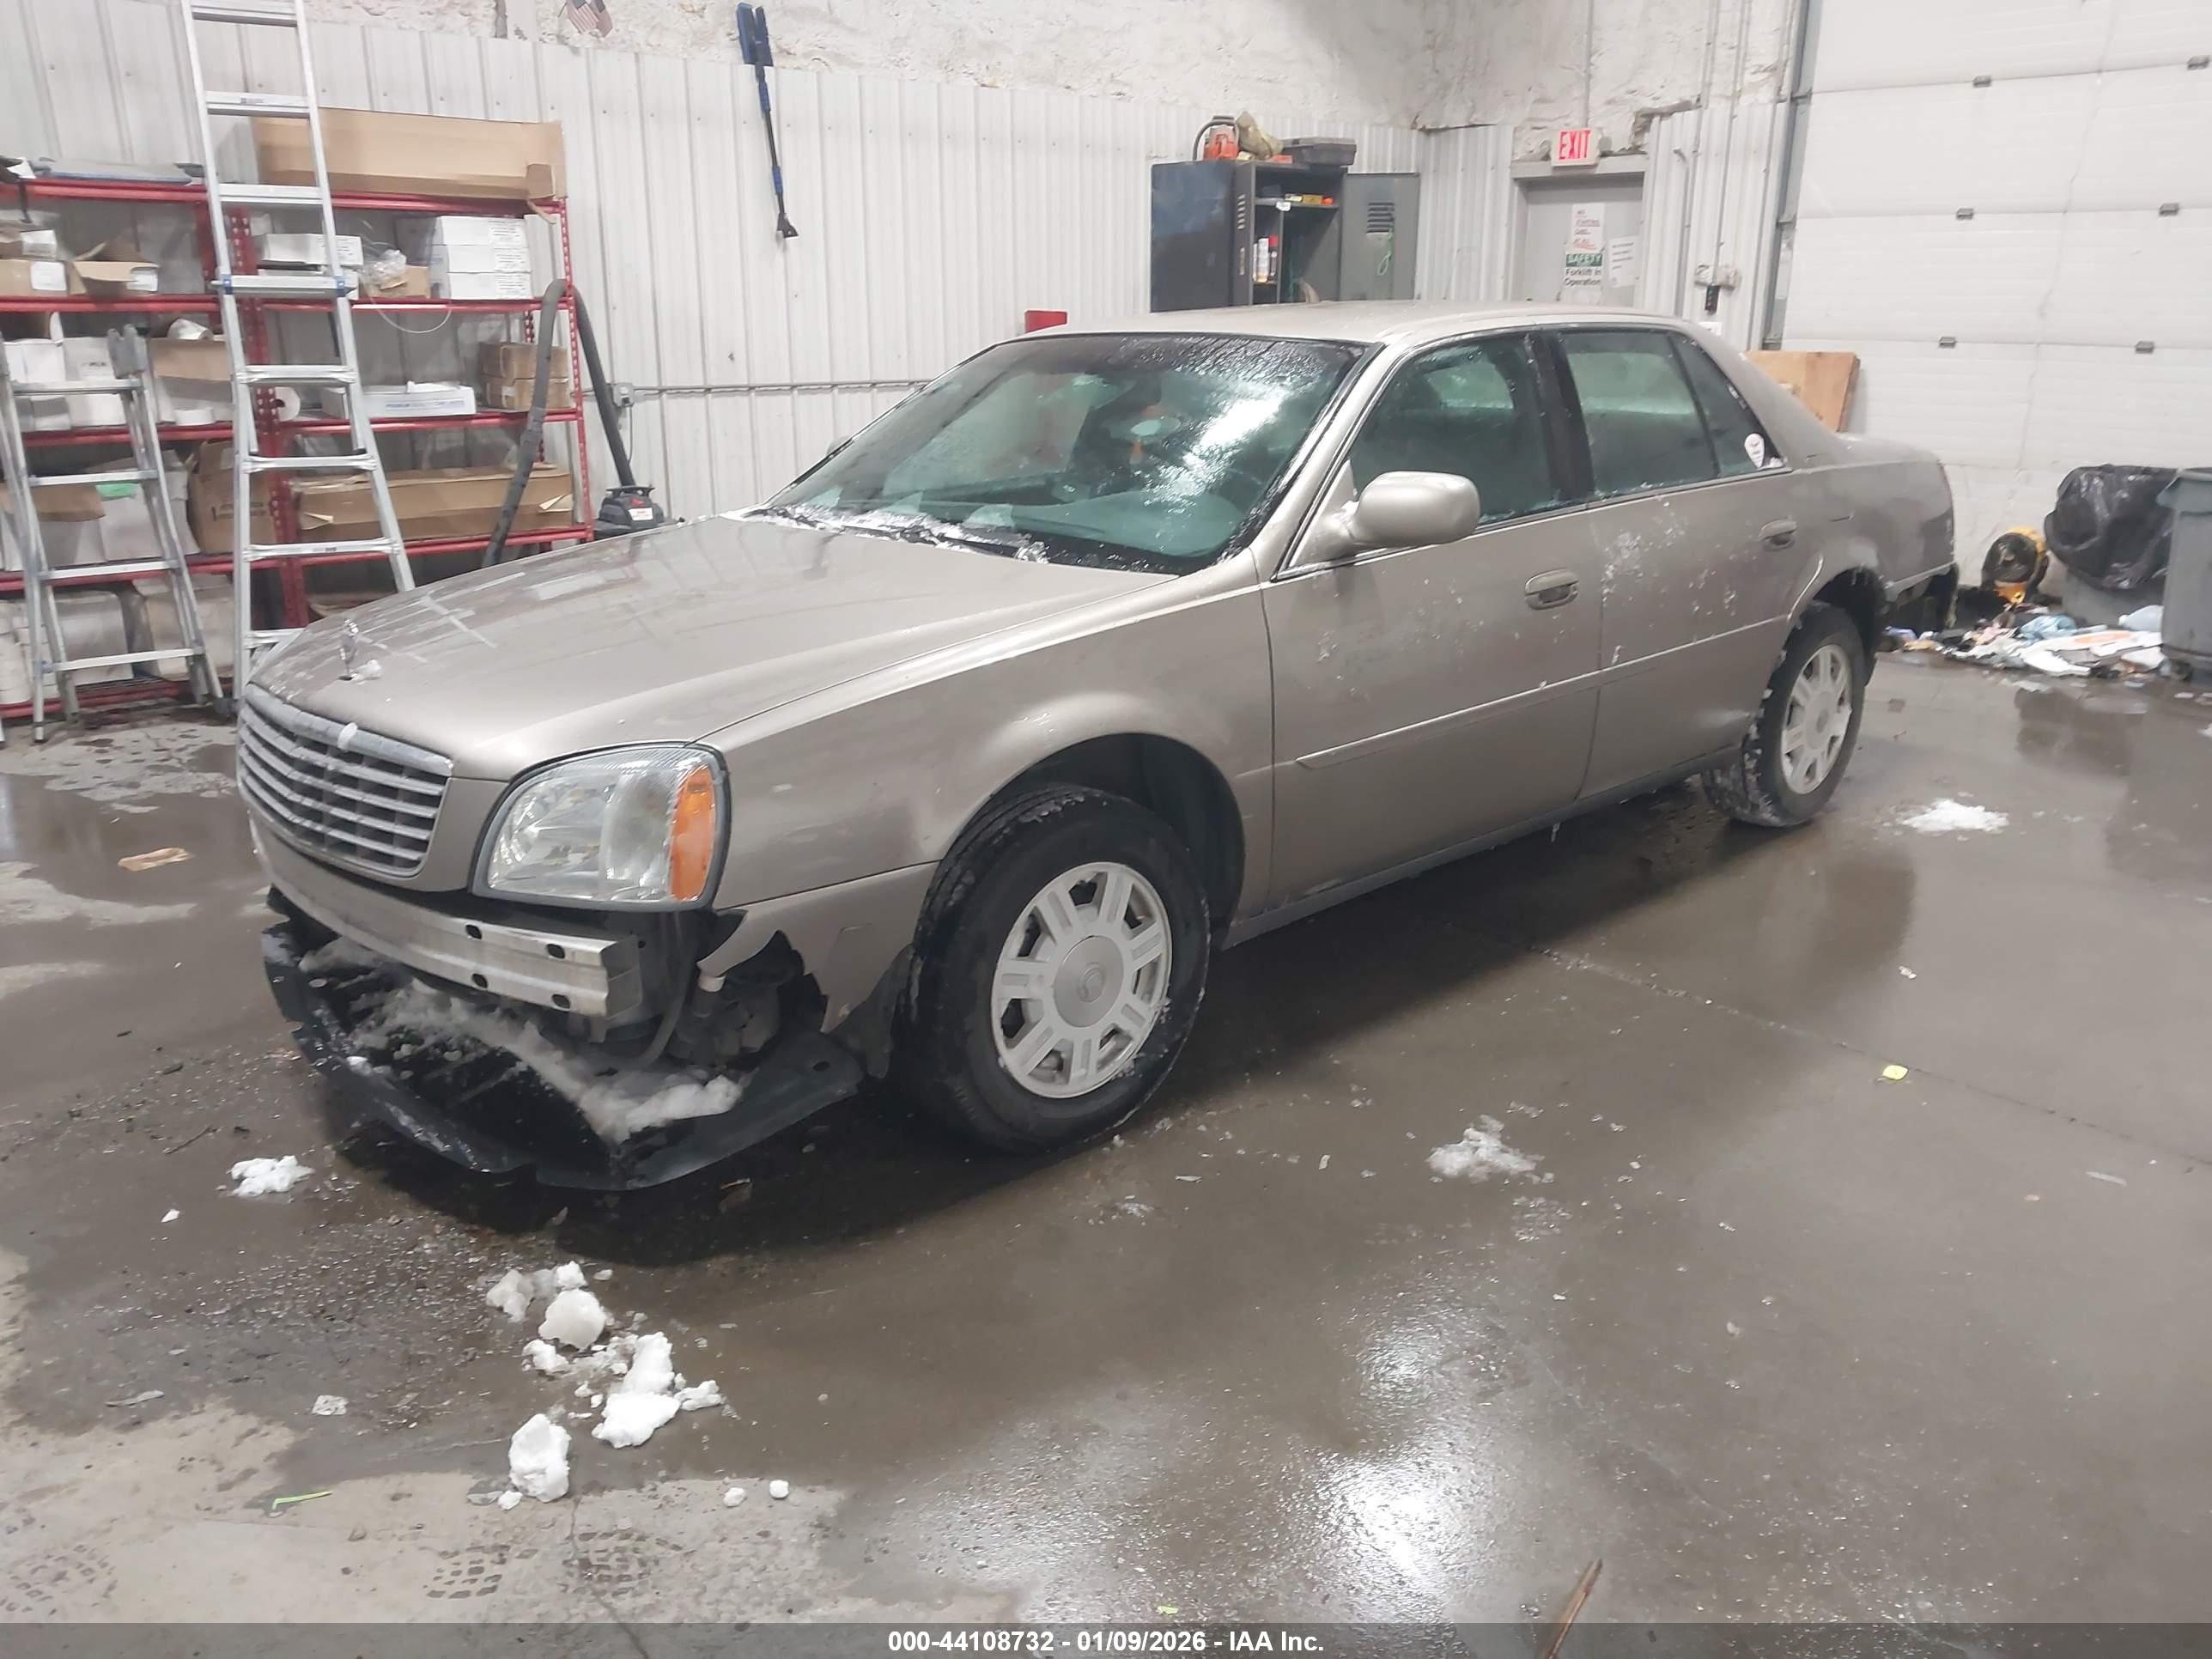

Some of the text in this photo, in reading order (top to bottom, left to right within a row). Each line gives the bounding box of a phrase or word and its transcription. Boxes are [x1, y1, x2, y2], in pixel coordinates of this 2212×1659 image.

[1559, 130, 1591, 160] EXIT
[1567, 253, 1602, 264] SAFETY
[1565, 277, 1601, 287] Operation
